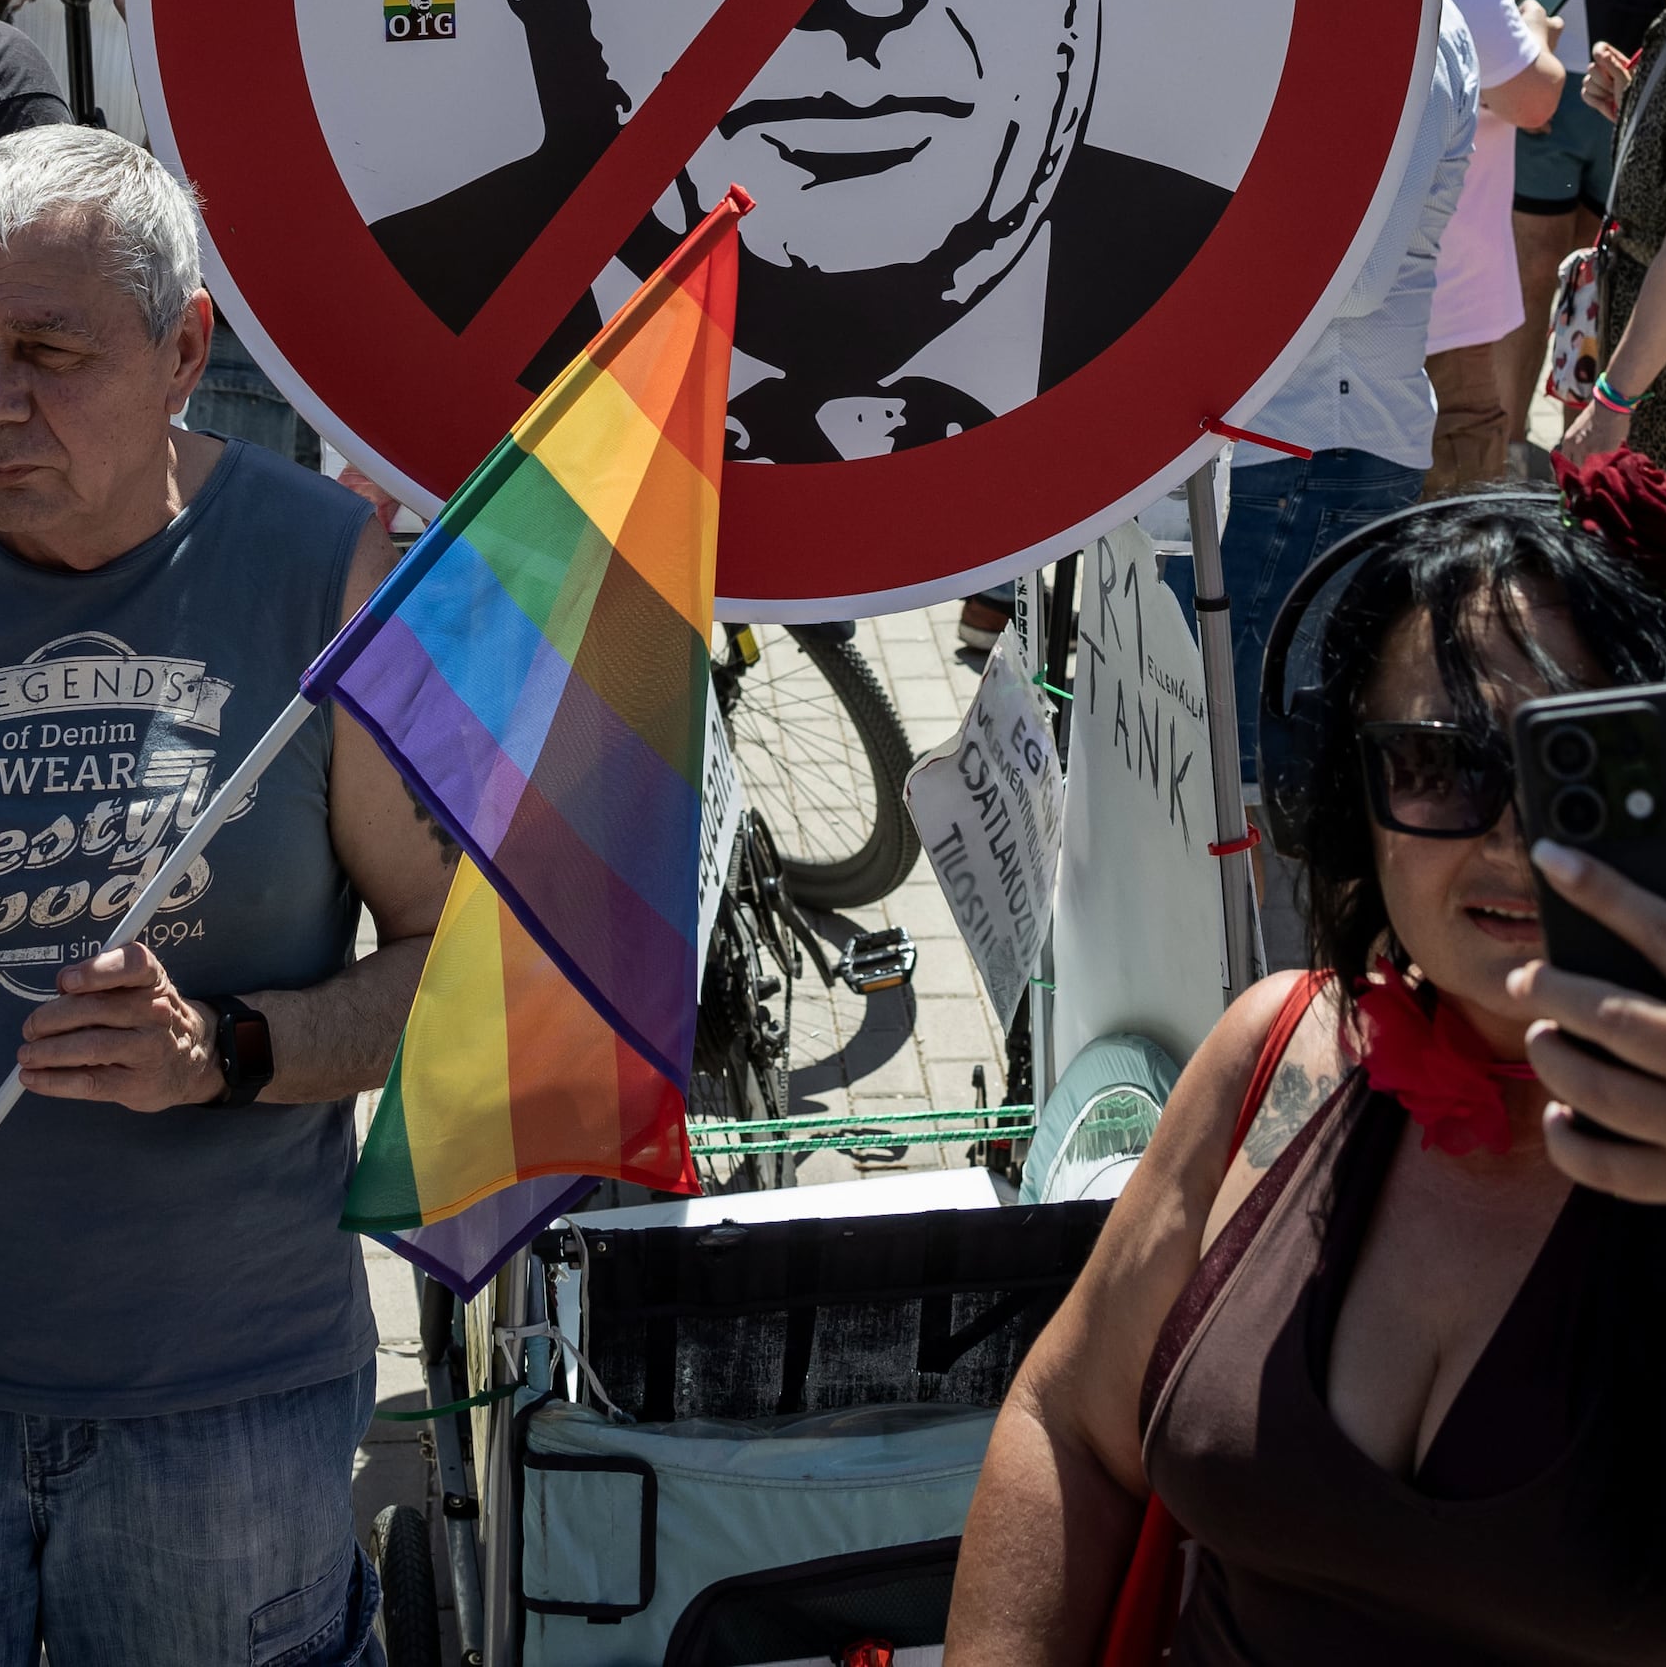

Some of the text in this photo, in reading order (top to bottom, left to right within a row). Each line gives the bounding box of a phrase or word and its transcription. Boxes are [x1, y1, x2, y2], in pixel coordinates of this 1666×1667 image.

[3, 721, 136, 750] of Denim
[1081, 630, 1193, 852] TANK
[143, 919, 205, 949] 1994
